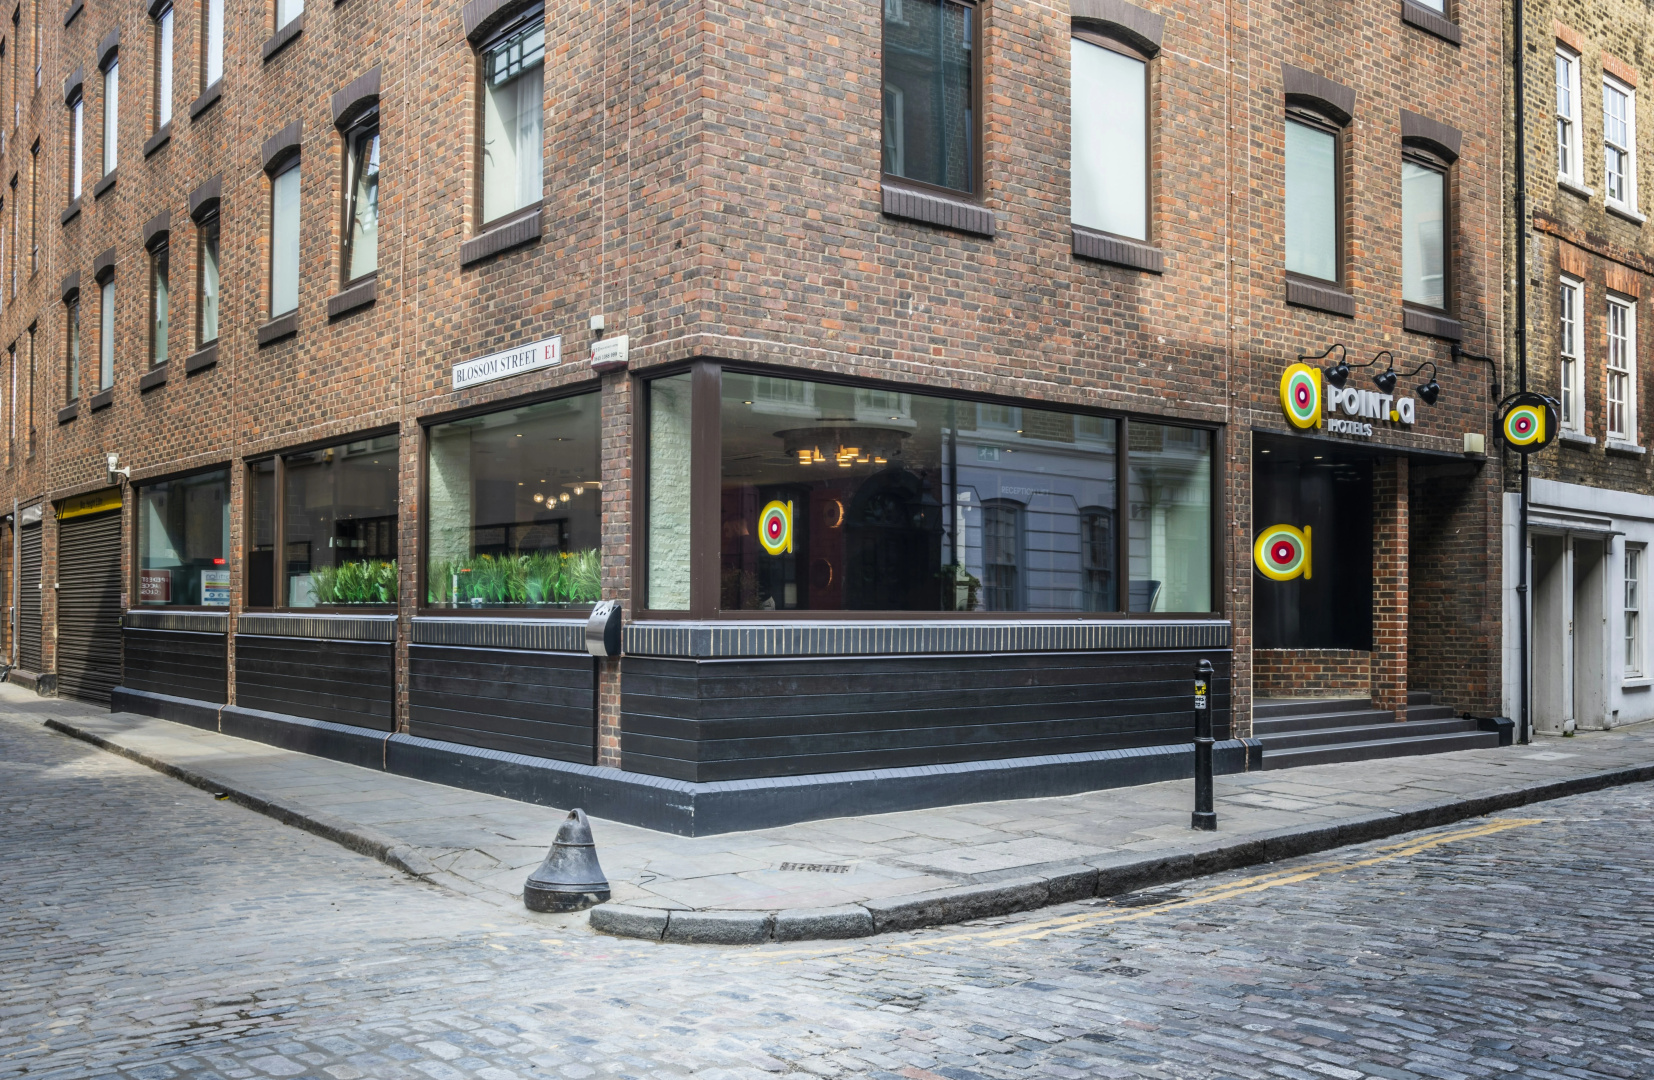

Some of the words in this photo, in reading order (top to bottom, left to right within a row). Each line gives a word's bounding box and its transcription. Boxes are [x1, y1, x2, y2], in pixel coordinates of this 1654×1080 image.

[456, 360, 498, 383] BLOSSOM
[500, 348, 537, 372] STREET
[544, 344, 556, 360] E1
[1327, 418, 1373, 437] HOTELS
